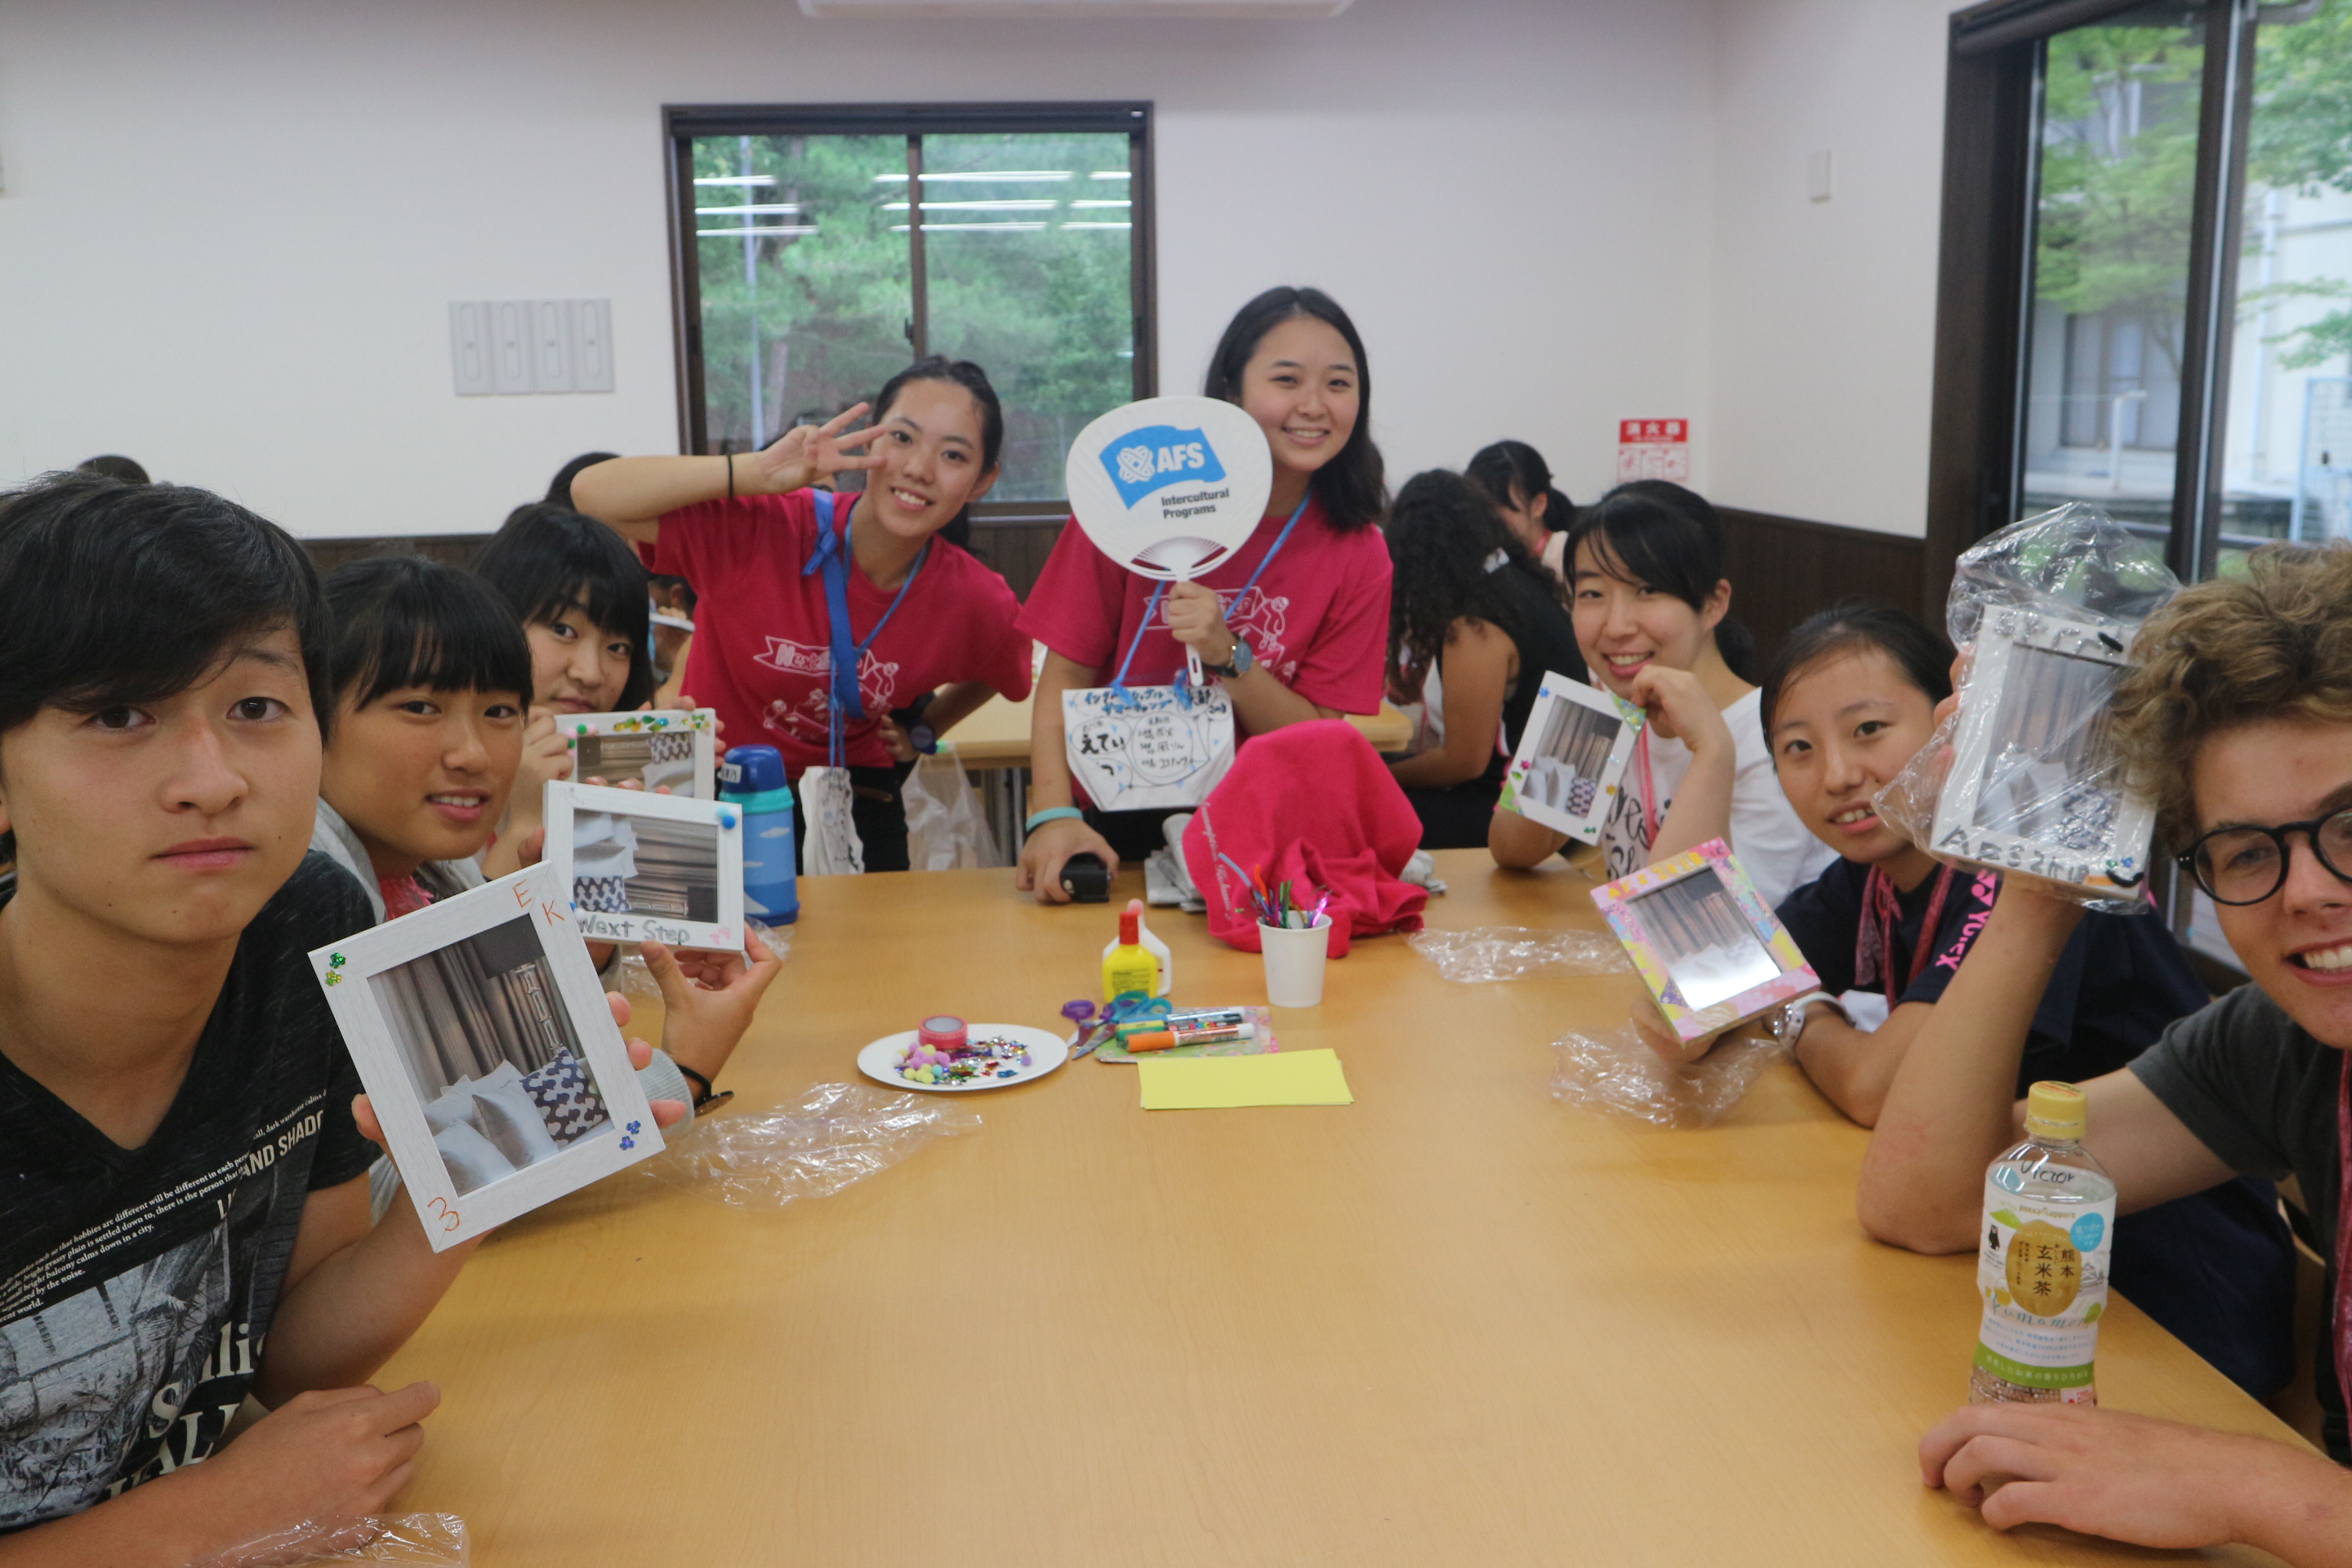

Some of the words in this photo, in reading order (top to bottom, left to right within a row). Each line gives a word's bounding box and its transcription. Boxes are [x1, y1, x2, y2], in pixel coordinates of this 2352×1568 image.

[1156, 442, 1206, 474] AFS
[1161, 488, 1229, 506] Intercultural
[1163, 504, 1216, 519] Programs
[514, 880, 532, 908] E
[541, 902, 565, 926] K
[579, 914, 635, 938] Next
[642, 919, 691, 946] Step
[266, 1120, 280, 1134] dark
[59, 1239, 73, 1252] that
[74, 1225, 101, 1243] hobbies
[102, 1218, 114, 1229] are
[114, 1201, 149, 1223] different
[149, 1193, 163, 1206] will
[163, 1190, 174, 1200] be
[174, 1174, 209, 1195] different
[207, 1171, 217, 1179] in
[216, 1160, 234, 1174] each
[427, 1196, 461, 1232] 3
[23, 1267, 44, 1282] bright
[44, 1254, 67, 1272] grassy
[68, 1242, 87, 1260] plain
[87, 1240, 94, 1248] is
[95, 1227, 121, 1244] settled
[122, 1216, 144, 1231] down
[144, 1211, 156, 1222] to,
[155, 1200, 176, 1215] there
[176, 1196, 185, 1206] is
[184, 1190, 198, 1202] the
[198, 1178, 225, 1198] person
[225, 1171, 238, 1183] that
[23, 1276, 46, 1293] bright
[46, 1262, 76, 1281] balcony
[76, 1250, 99, 1265] calms
[100, 1239, 122, 1254] down
[122, 1235, 131, 1243] in
[137, 1223, 155, 1236] city.
[2033, 1245, 2054, 1296] 玄米茶
[2060, 1249, 2075, 1279] 熊本
[36, 1285, 46, 1296] by
[47, 1280, 60, 1290] the
[60, 1268, 87, 1284] noise.
[16, 1298, 44, 1315] world.
